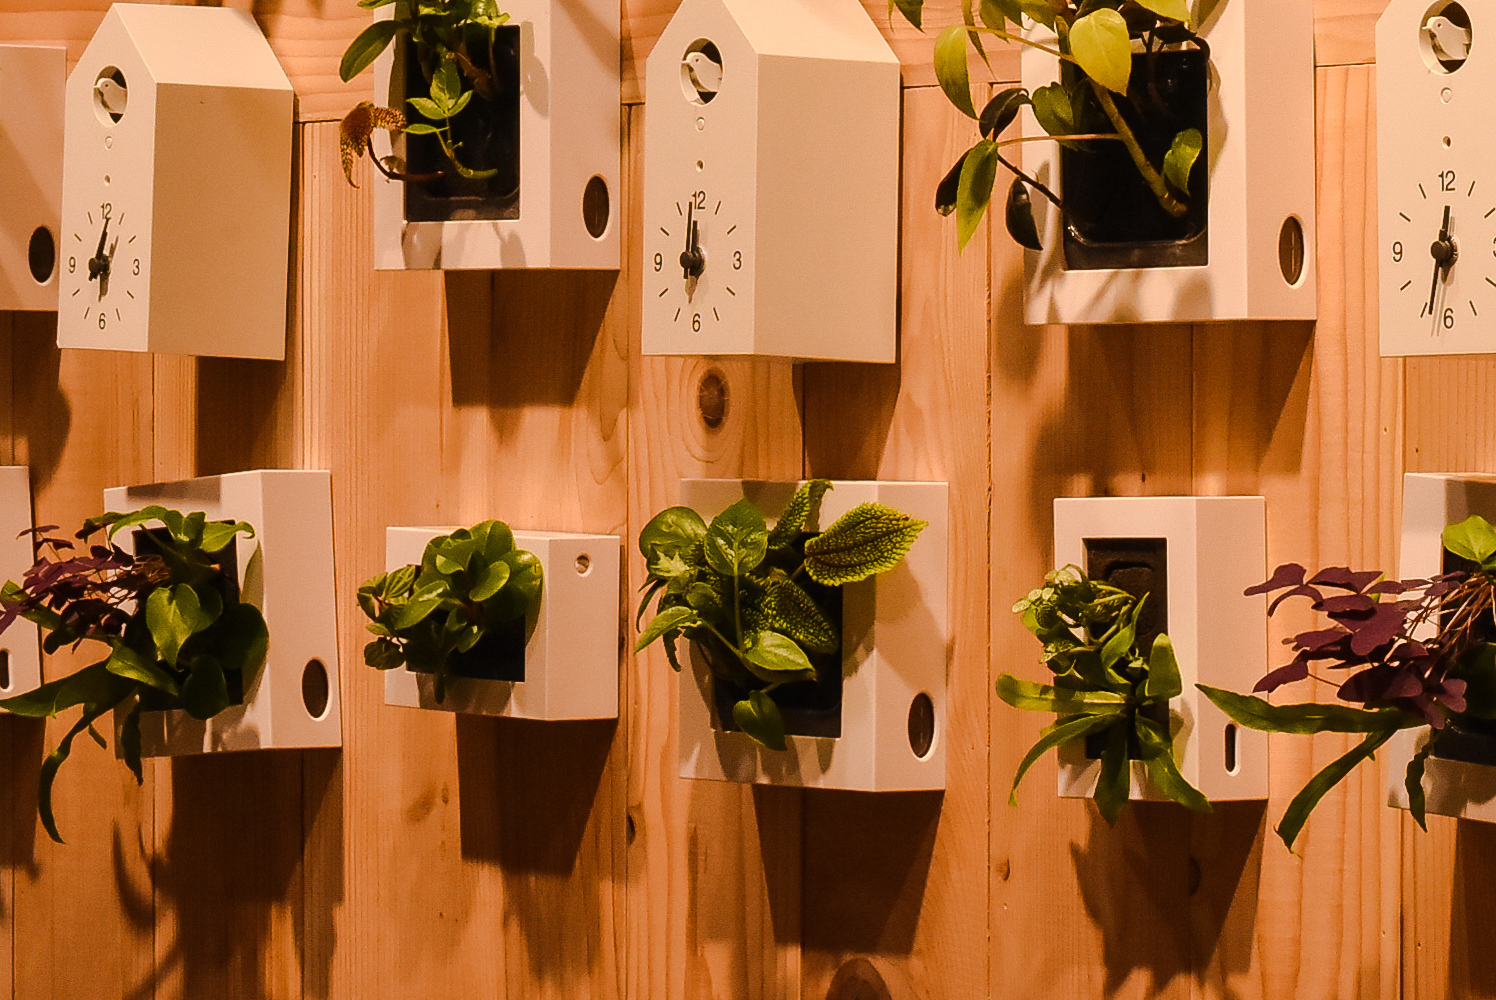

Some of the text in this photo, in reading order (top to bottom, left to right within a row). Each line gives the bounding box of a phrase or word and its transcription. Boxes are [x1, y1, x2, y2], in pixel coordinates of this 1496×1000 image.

[1438, 171, 1455, 191] 12
[692, 191, 705, 210] 12
[101, 203, 112, 220] 12
[733, 251, 741, 270] 3
[1393, 241, 1402, 262] 9
[69, 257, 75, 273] 9
[133, 259, 139, 275] 3
[654, 253, 662, 272] 9
[99, 313, 105, 329] 6
[692, 313, 700, 332] 6
[1443, 308, 1453, 329] 6
